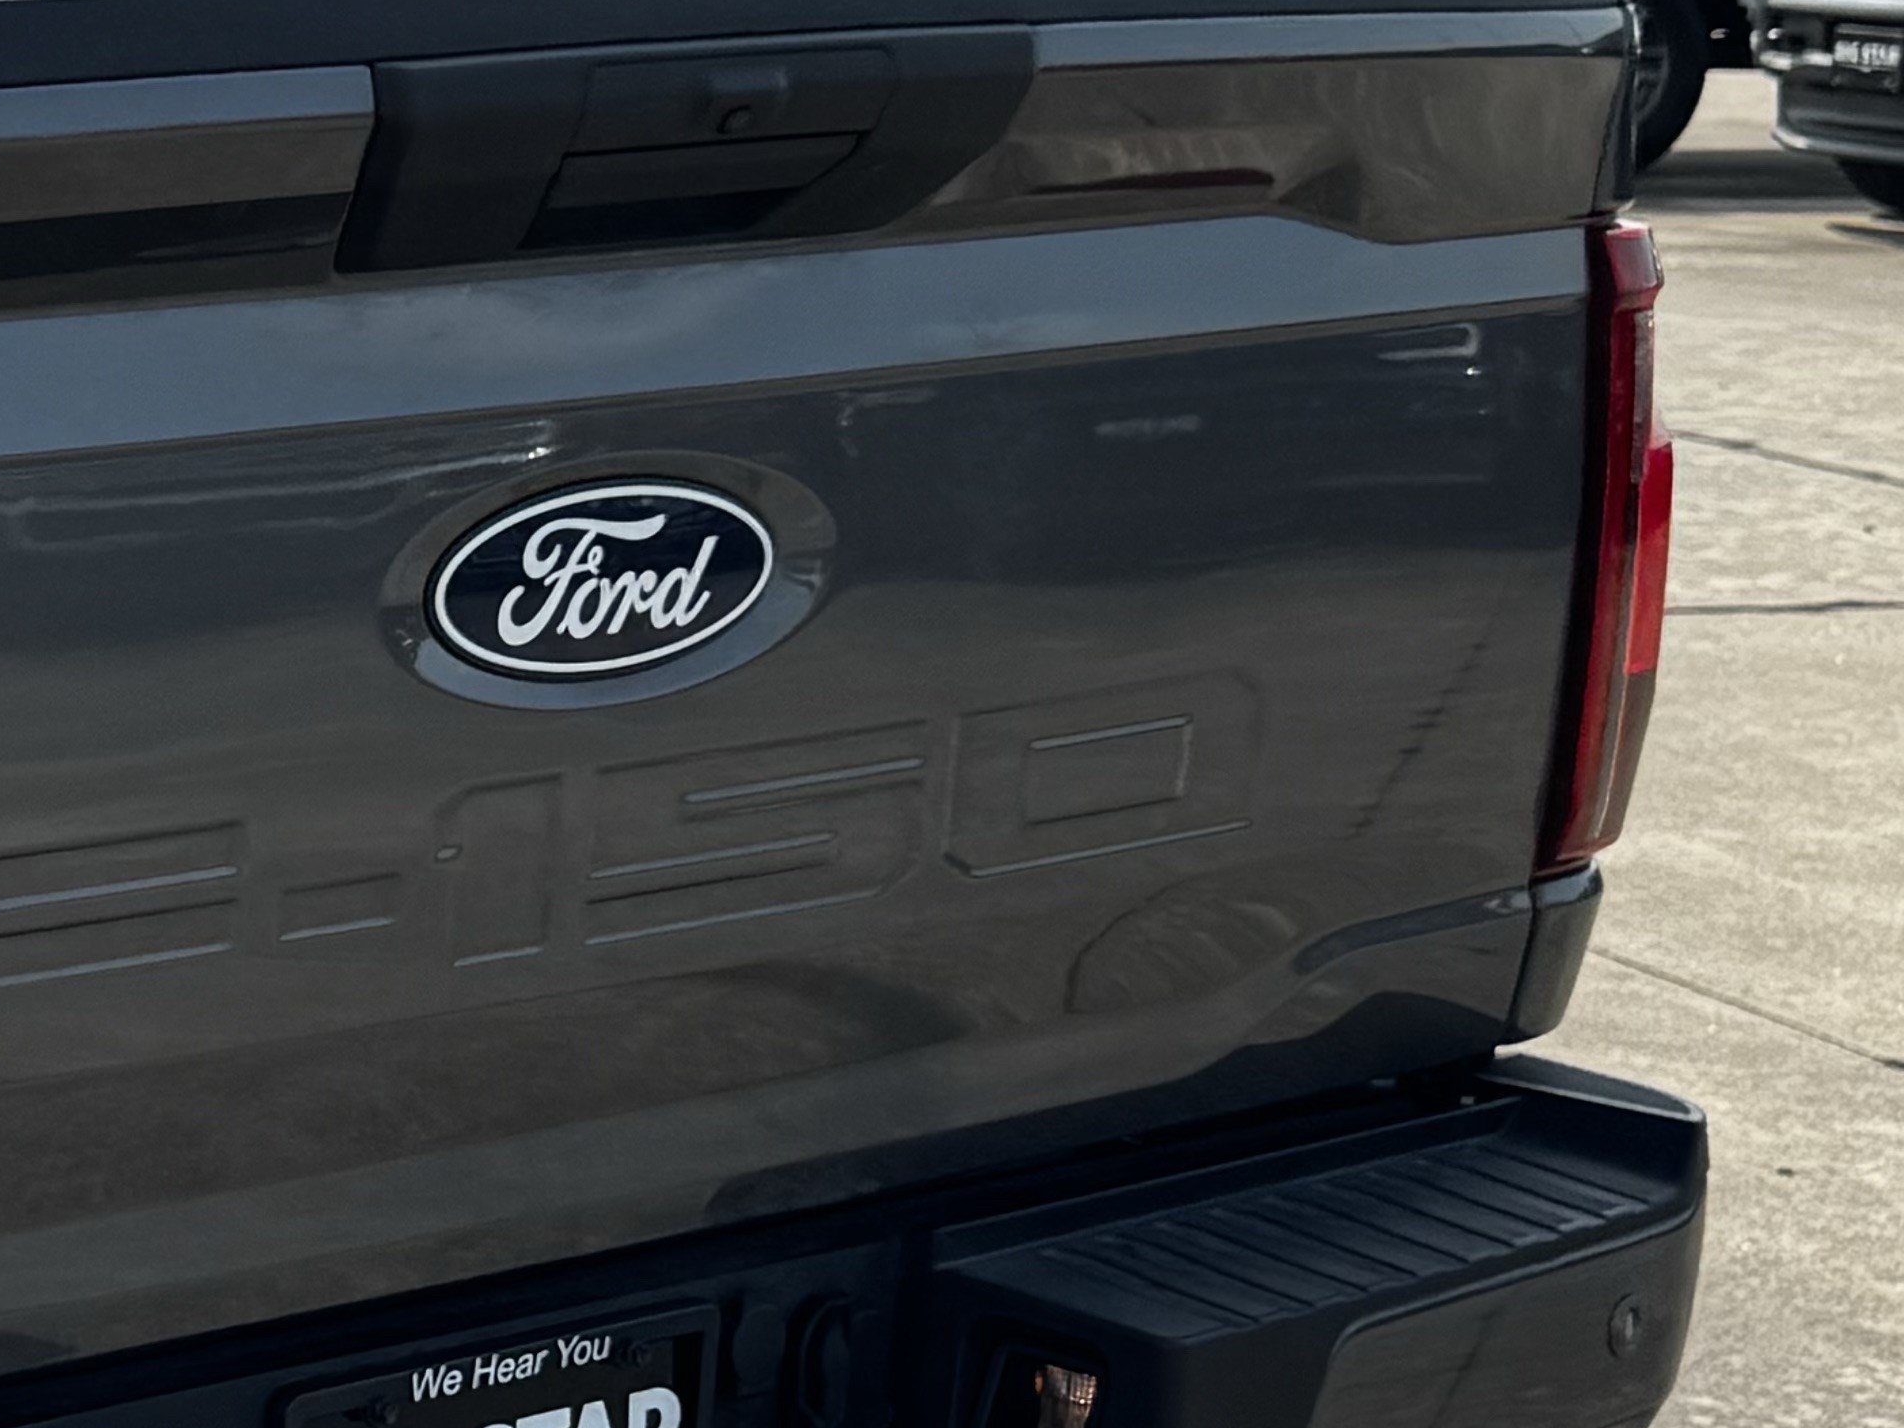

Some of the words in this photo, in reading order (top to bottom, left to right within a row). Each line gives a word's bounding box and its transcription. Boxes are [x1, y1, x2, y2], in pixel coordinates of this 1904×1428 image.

[497, 513, 720, 647] Ford
[411, 1363, 464, 1403] We
[470, 1349, 550, 1390] Hear
[556, 1334, 612, 1369] You
